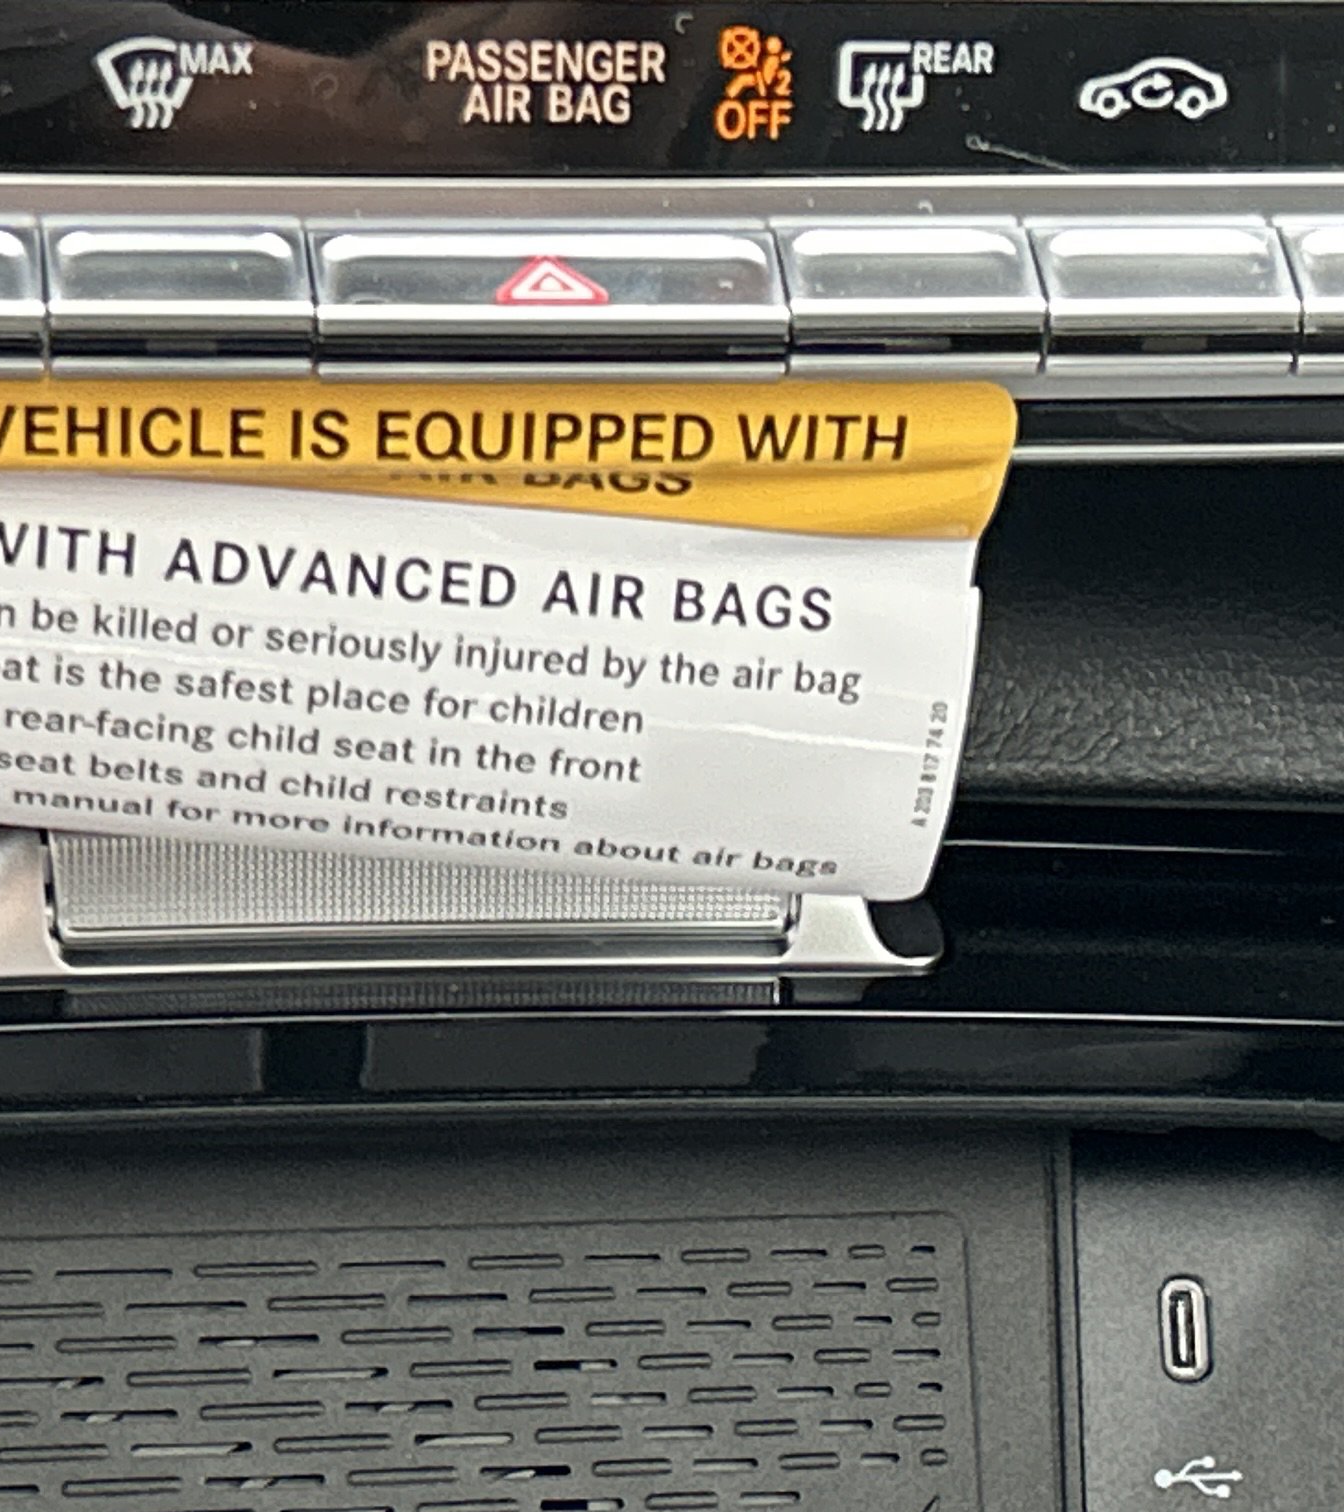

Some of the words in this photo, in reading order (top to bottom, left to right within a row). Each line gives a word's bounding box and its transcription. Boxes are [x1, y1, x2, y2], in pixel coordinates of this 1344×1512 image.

[178, 43, 253, 76] MAX
[426, 40, 666, 83] PASSENGER
[913, 43, 995, 74] REAR
[463, 85, 530, 124] AIR
[548, 86, 631, 124] BAG
[716, 102, 792, 140] OFF
[290, 407, 350, 461] IS
[375, 410, 714, 463] EQUIPPED
[738, 413, 908, 462] WITH
[164, 536, 516, 607] ADVANCED
[542, 569, 646, 621] AIR
[673, 578, 833, 631] BAGS
[32, 599, 78, 633] be
[93, 600, 196, 645] killed
[212, 618, 253, 649] or
[265, 622, 442, 669] seriously
[455, 635, 588, 678] injured
[602, 644, 646, 688] by
[660, 651, 718, 687] the
[733, 657, 779, 692] air
[795, 661, 861, 705] bag
[55, 652, 84, 688] is
[99, 657, 159, 693] the
[175, 665, 293, 707] safest
[307, 675, 409, 716] place
[424, 687, 477, 722] for
[489, 694, 643, 734] children
[4, 706, 213, 752] rear-facing
[227, 718, 318, 756] child
[334, 729, 415, 765] seat
[428, 737, 461, 769] in
[476, 743, 535, 775] the
[549, 750, 641, 784] front
[90, 754, 183, 787] belts
[197, 763, 265, 794] and
[280, 771, 369, 804] child
[385, 782, 567, 820] restraints
[13, 783, 154, 817] manual
[167, 798, 221, 824] for
[233, 808, 328, 834] more
[342, 816, 560, 855] information
[573, 836, 681, 865] about
[693, 846, 743, 870] air
[753, 850, 837, 879] bags
